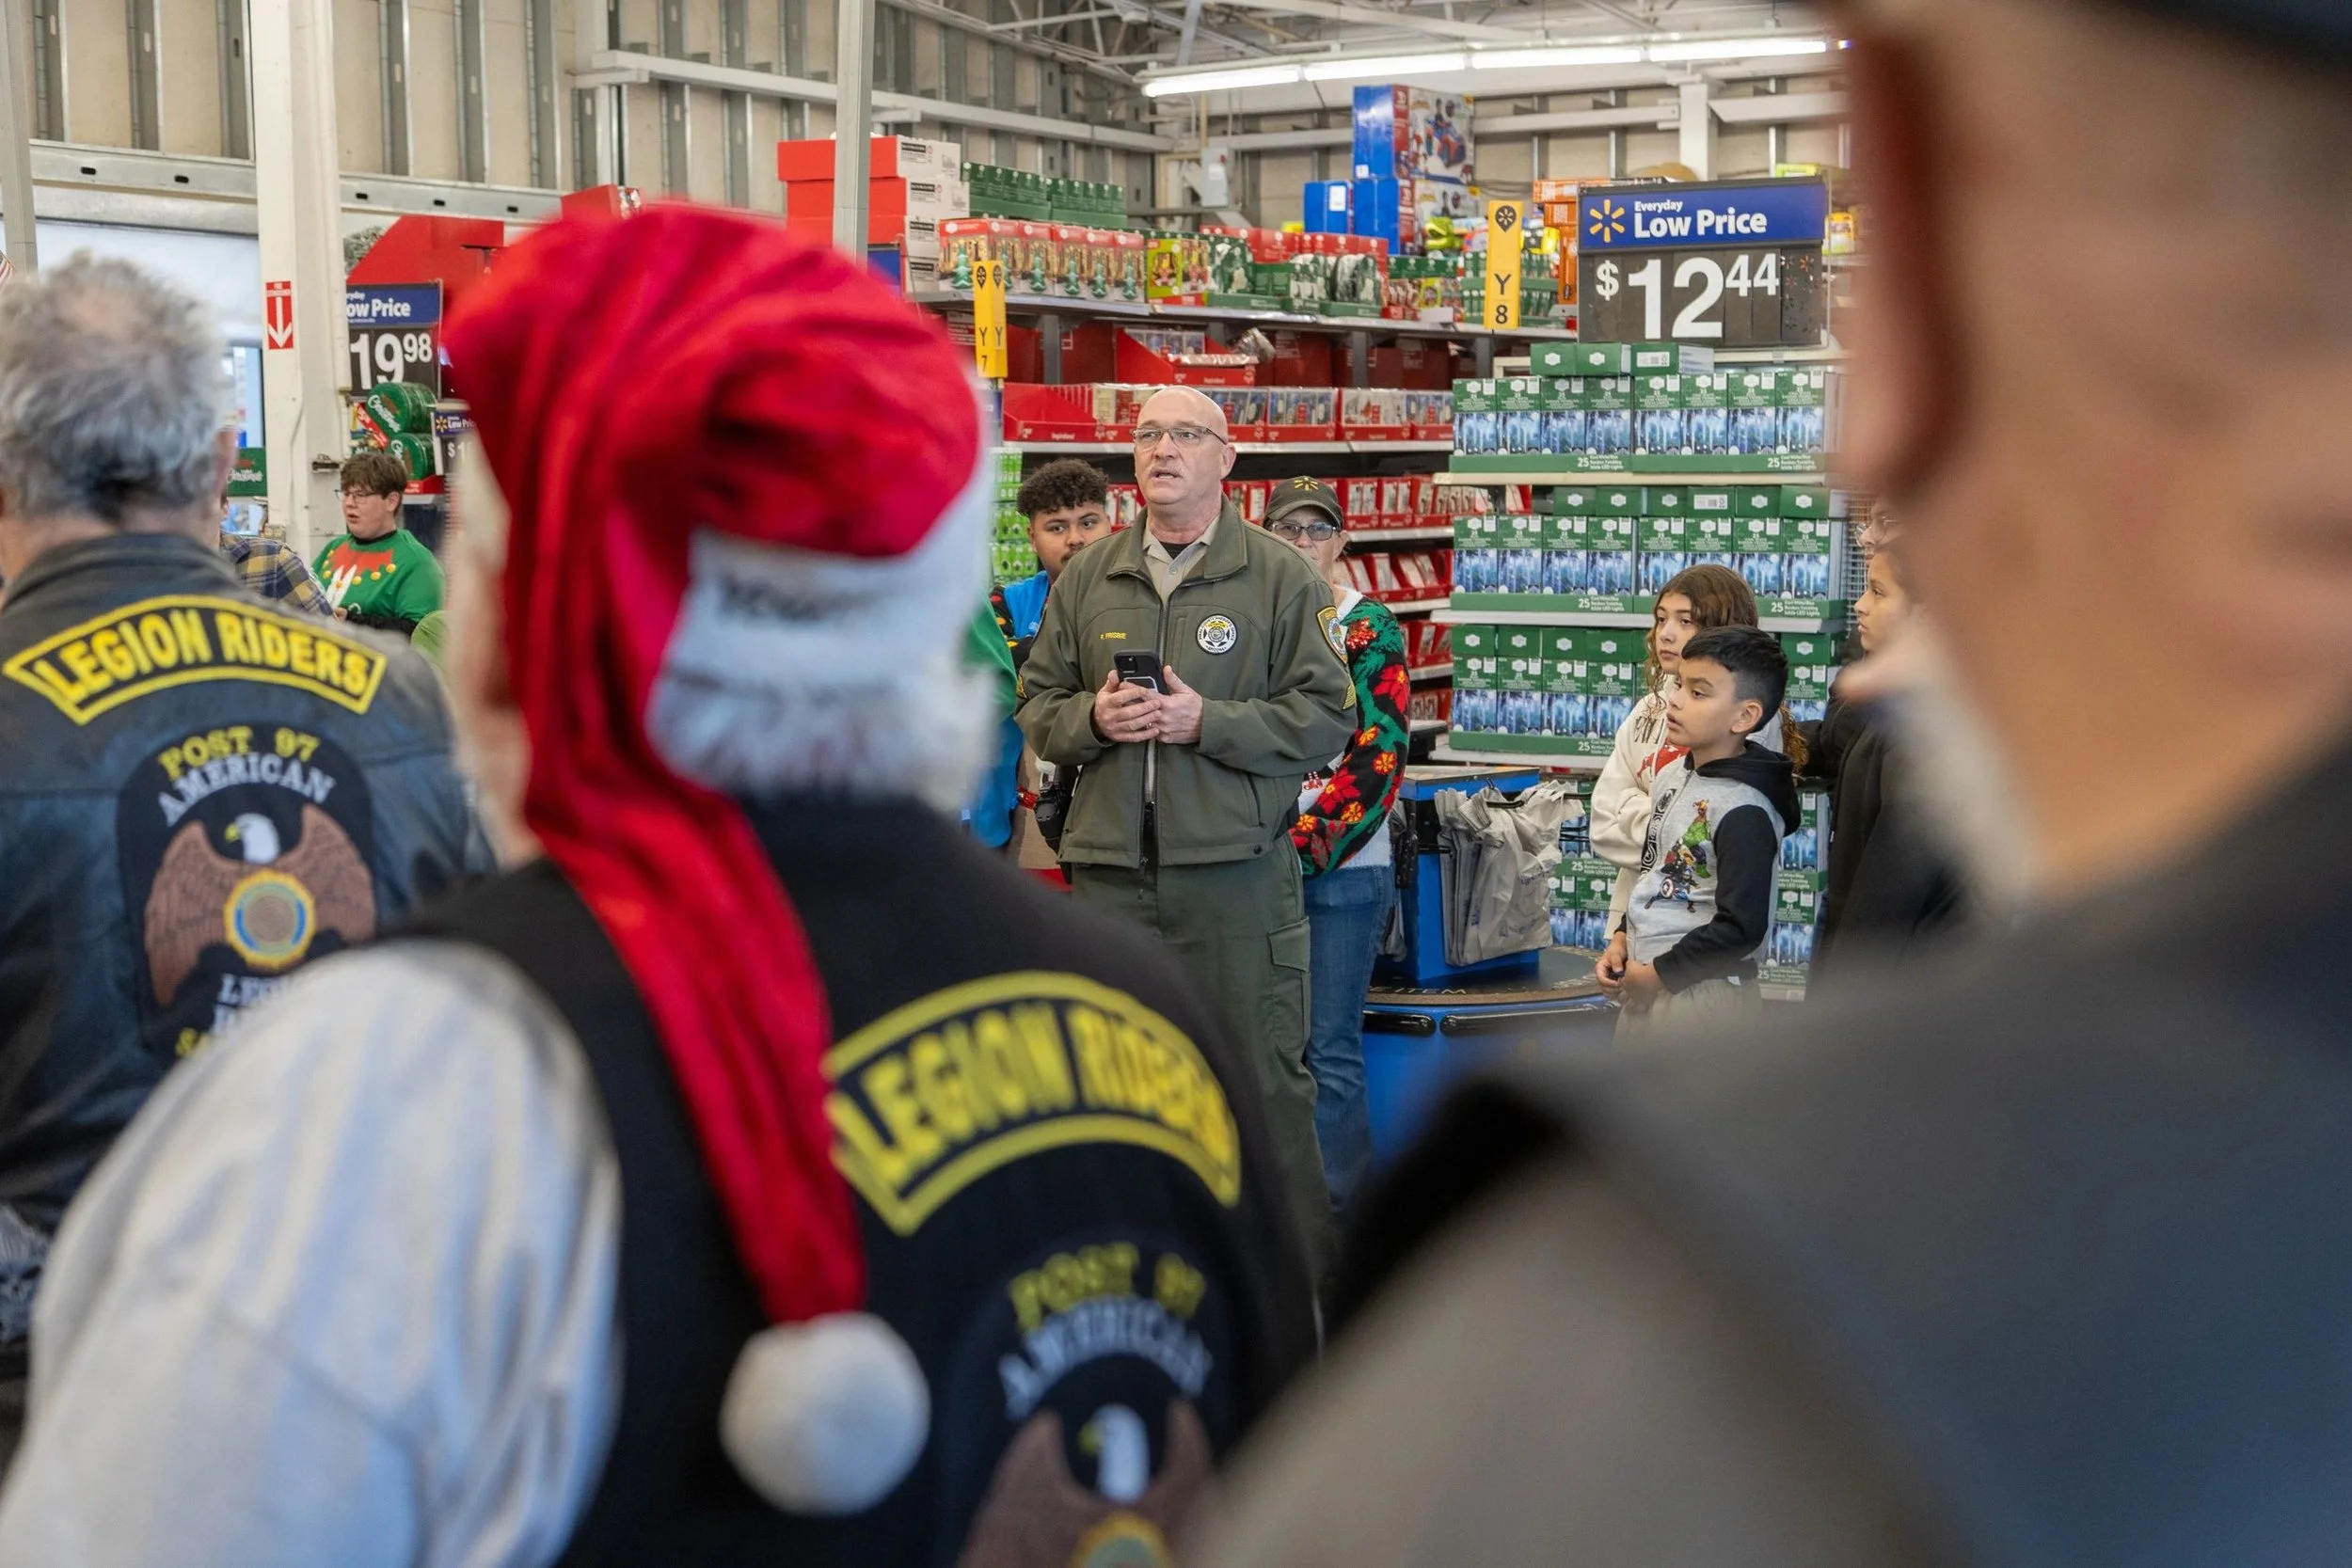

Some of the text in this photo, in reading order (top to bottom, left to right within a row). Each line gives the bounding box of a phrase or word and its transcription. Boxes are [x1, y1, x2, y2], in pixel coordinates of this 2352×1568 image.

[1634, 198, 1683, 214] Everyday
[1634, 207, 1767, 238] Low Price
[1494, 274, 1512, 295] Y
[346, 297, 411, 318] ow Price
[1496, 305, 1508, 324] 8
[978, 326, 988, 347] Y
[1577, 457, 1590, 467] 25
[1768, 457, 1780, 467] 25
[1579, 598, 1590, 609] 25
[1771, 602, 1784, 612] 25
[33, 609, 373, 701] LEGION RIDERS
[157, 725, 320, 782] POST 97
[158, 752, 336, 827] AMERICAN
